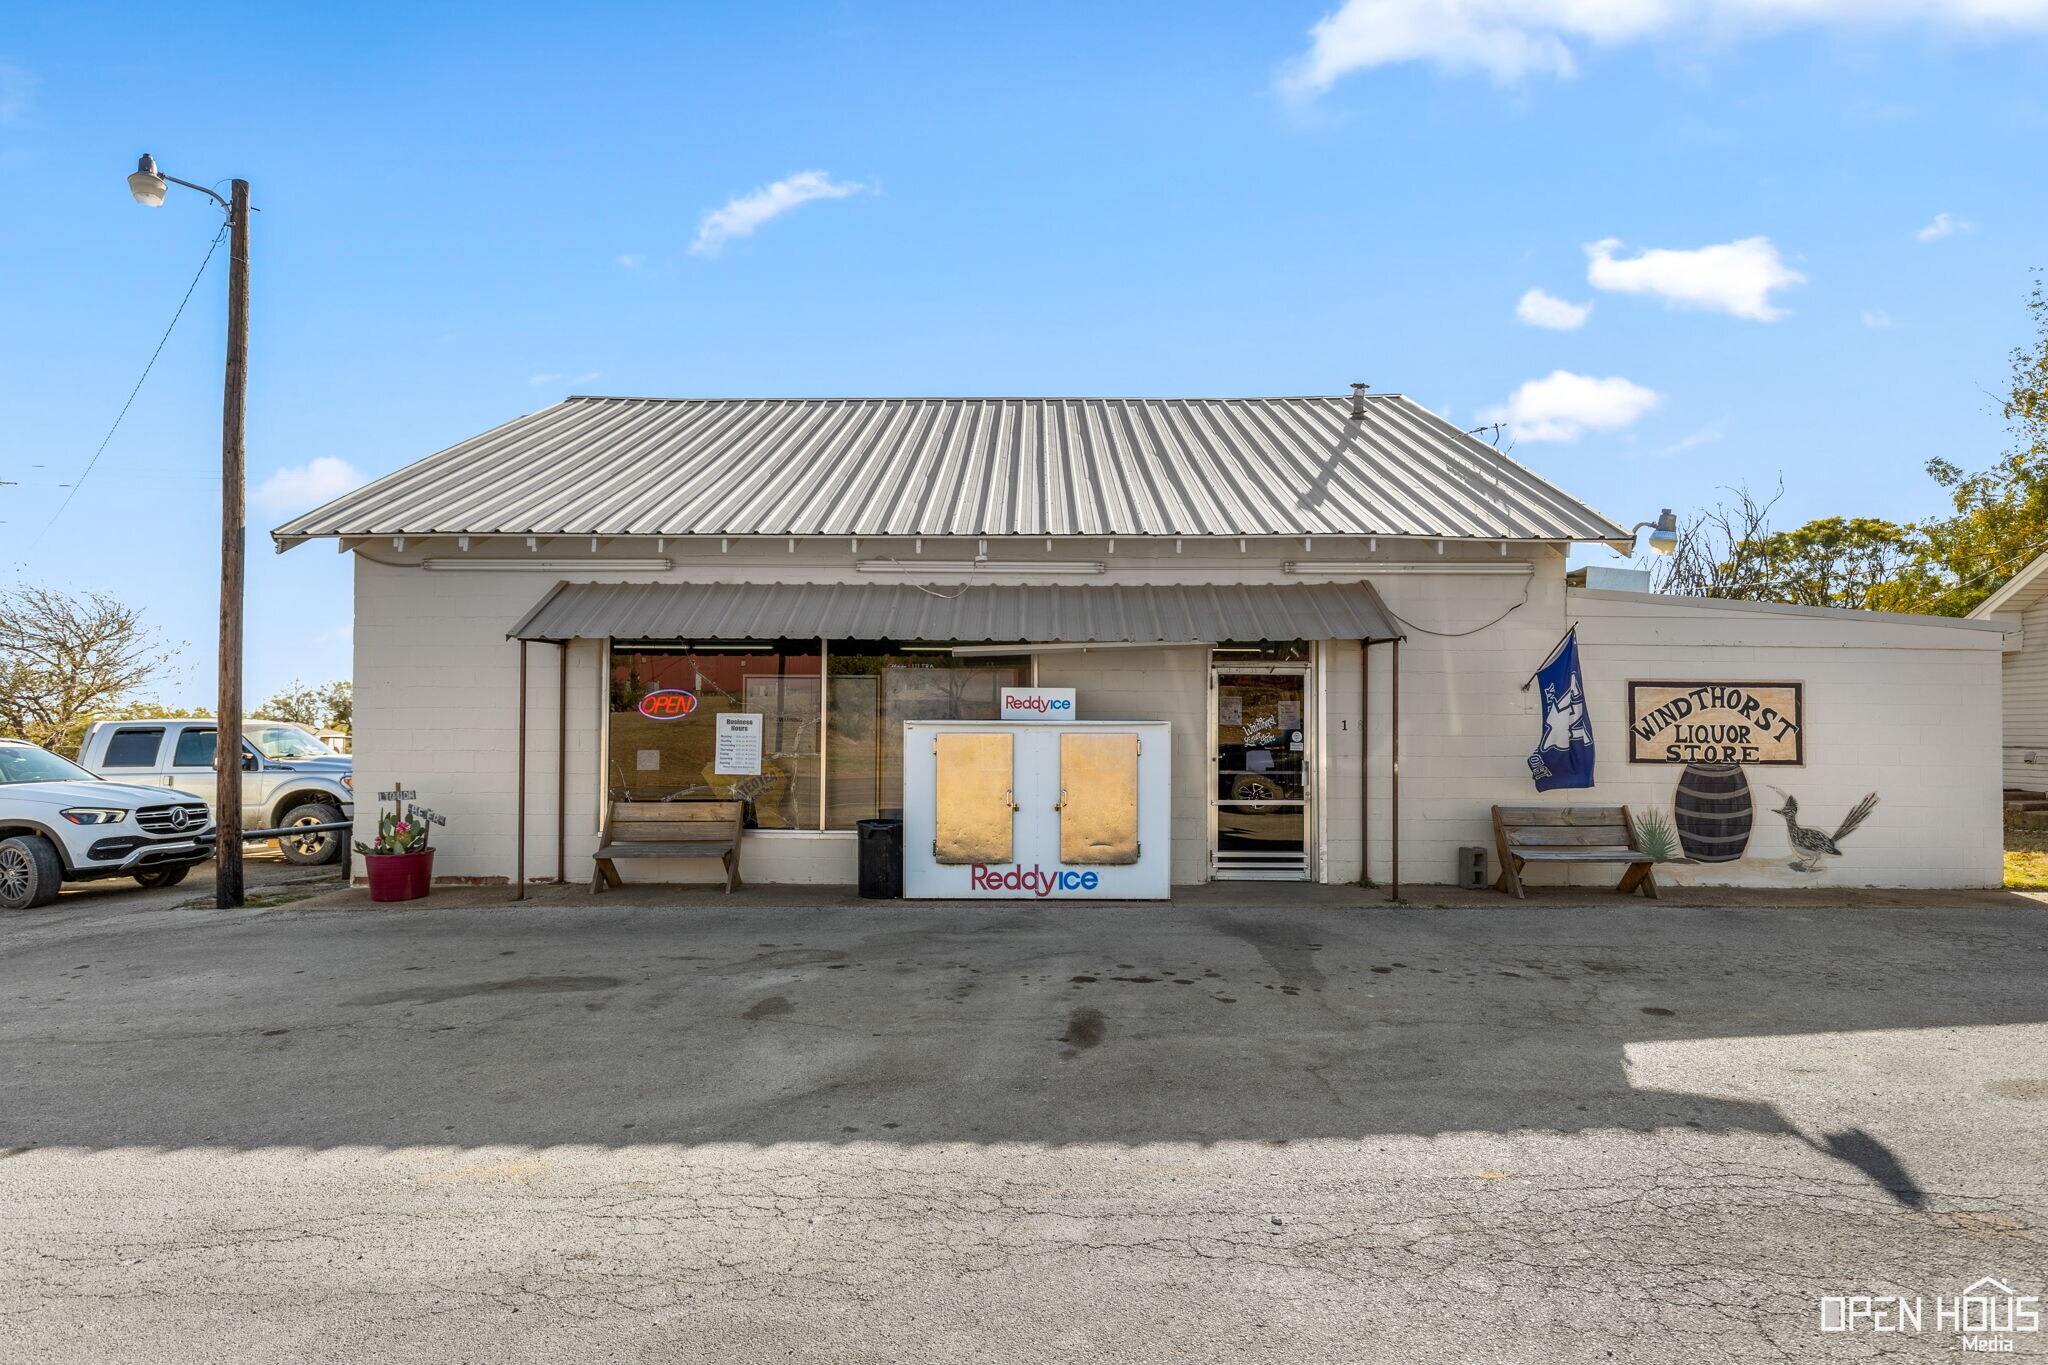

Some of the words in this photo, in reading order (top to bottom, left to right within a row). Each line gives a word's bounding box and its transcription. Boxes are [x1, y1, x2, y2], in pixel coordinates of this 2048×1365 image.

[641, 695, 692, 714] OPEN
[1630, 686, 1799, 742] WINDTHORST
[1674, 724, 1751, 744] LIQUOR
[1666, 744, 1760, 763] STORE
